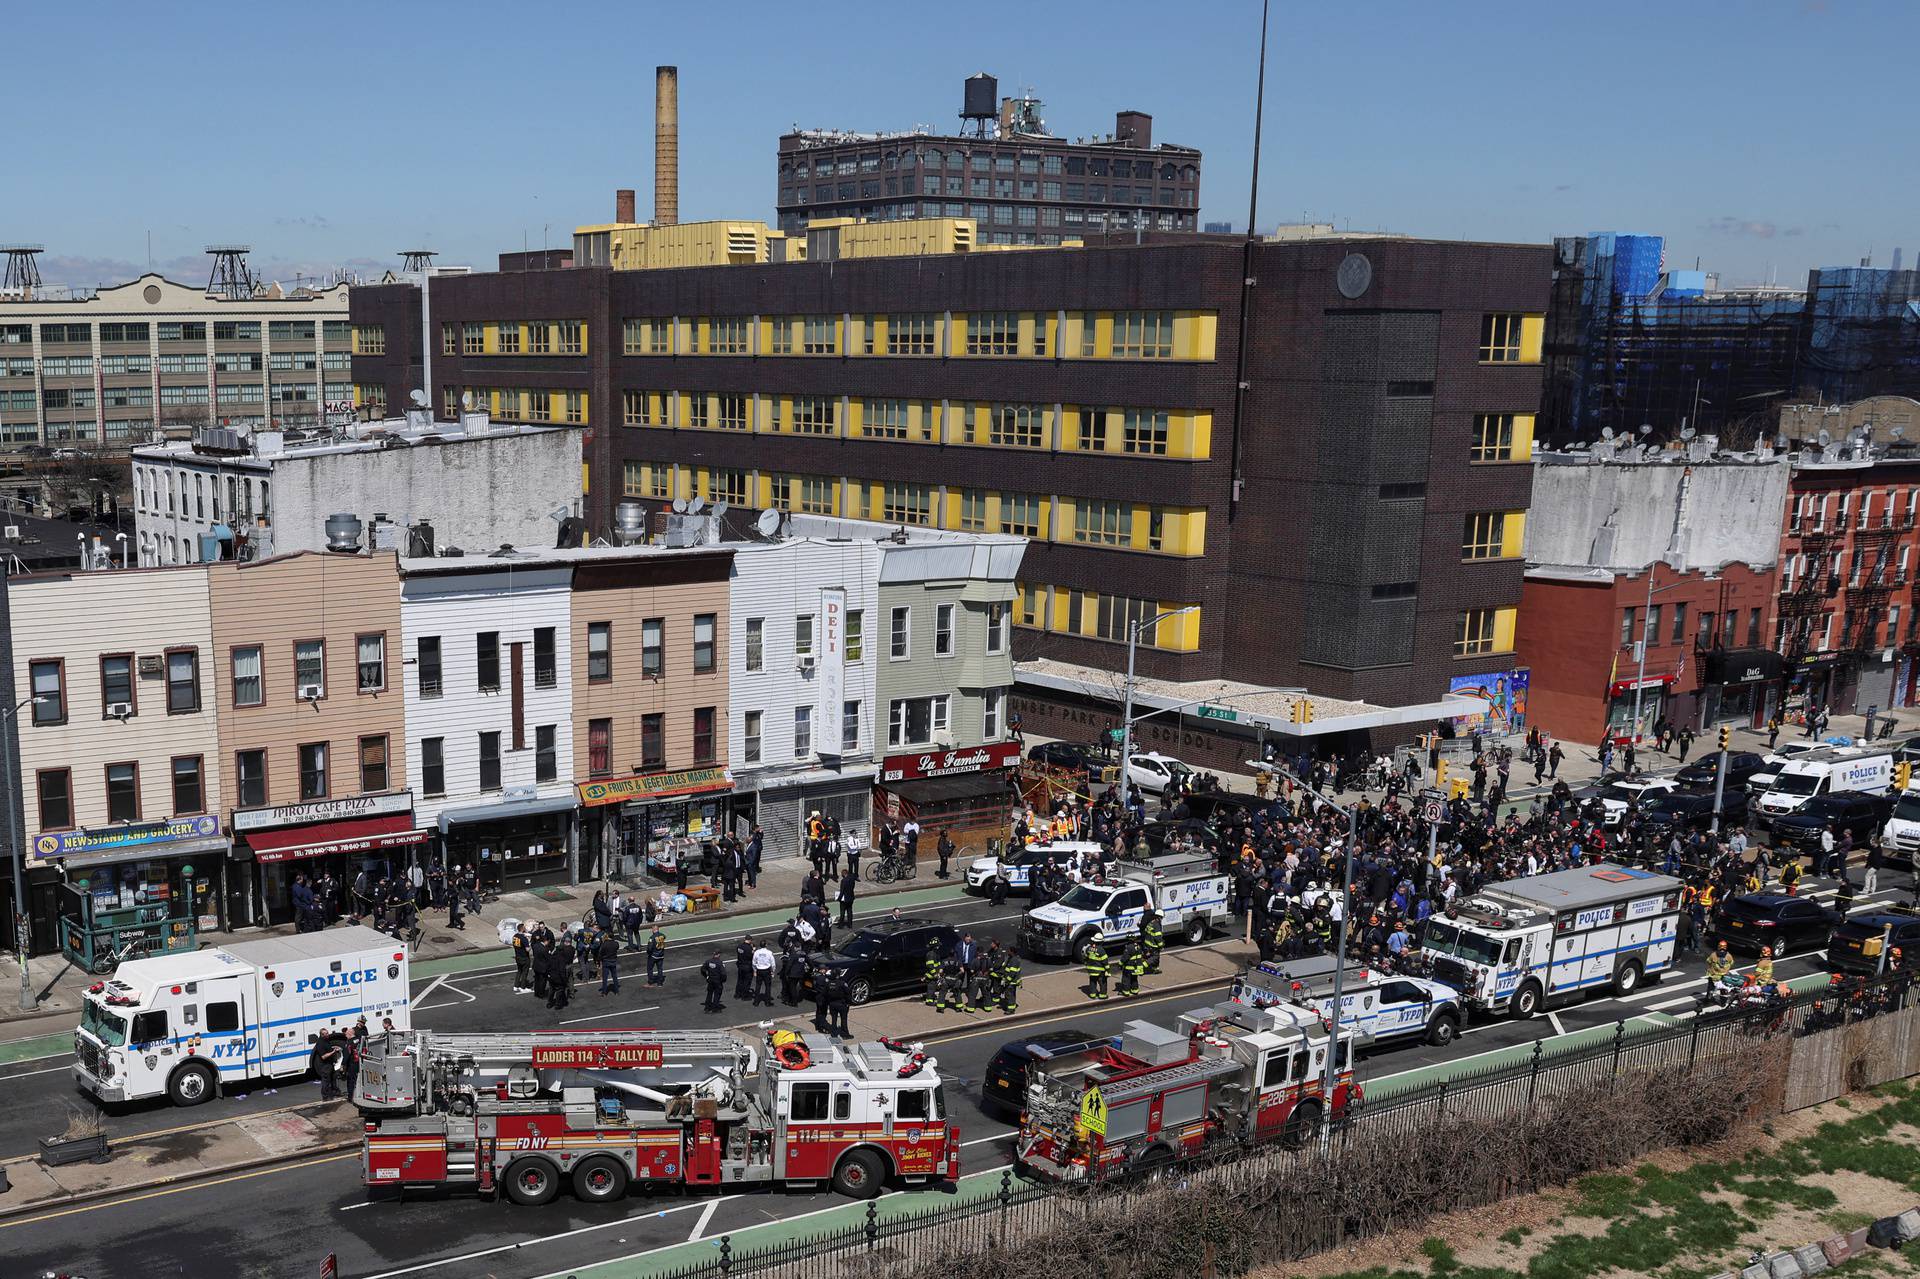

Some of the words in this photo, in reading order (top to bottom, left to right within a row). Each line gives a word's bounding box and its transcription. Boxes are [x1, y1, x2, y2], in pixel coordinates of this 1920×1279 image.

[828, 603, 838, 652] DELI
[1012, 696, 1055, 717] UNSET
[1062, 708, 1095, 727] PARK
[1152, 726, 1214, 750] SCHOOL
[918, 755, 936, 771] La
[943, 749, 991, 768] Familia
[887, 771, 900, 780] 935
[928, 765, 978, 777] RESTAURANT
[1849, 766, 1878, 779] POLICE
[608, 781, 634, 793] FRUITS
[635, 780, 642, 790] &
[641, 773, 687, 790] VEGETABLES
[687, 769, 717, 783] MARKET
[315, 799, 341, 813] CAFE
[345, 797, 376, 810] PIZZA
[64, 831, 124, 848] NEWSSTAND
[127, 829, 147, 841] AND
[150, 823, 193, 838] GROCERY
[380, 838, 395, 846] FREE
[396, 835, 423, 844] DELIVERY
[294, 849, 304, 857] TEL:
[1186, 881, 1211, 893] POLICE
[1632, 900, 1659, 909] EMERGENCY
[1578, 908, 1612, 926] POLICE
[119, 930, 145, 939] Subway
[295, 968, 377, 993] POLICE
[312, 991, 330, 999] BOMB
[1255, 988, 1278, 1000] NYPD
[1325, 996, 1354, 1009] POICE
[1398, 1009, 1423, 1023] NYPD
[211, 1038, 257, 1058] NYPD
[536, 1051, 575, 1063] LADDER
[577, 1051, 594, 1063] 114
[614, 1050, 644, 1062] TALLY
[646, 1050, 660, 1061] HO
[1266, 1090, 1286, 1107] 228
[1082, 1115, 1105, 1131] SCHOOL
[516, 1137, 531, 1149] FD
[531, 1137, 548, 1149] NY
[799, 1130, 820, 1143] 114
[1049, 1147, 1060, 1161] 22
